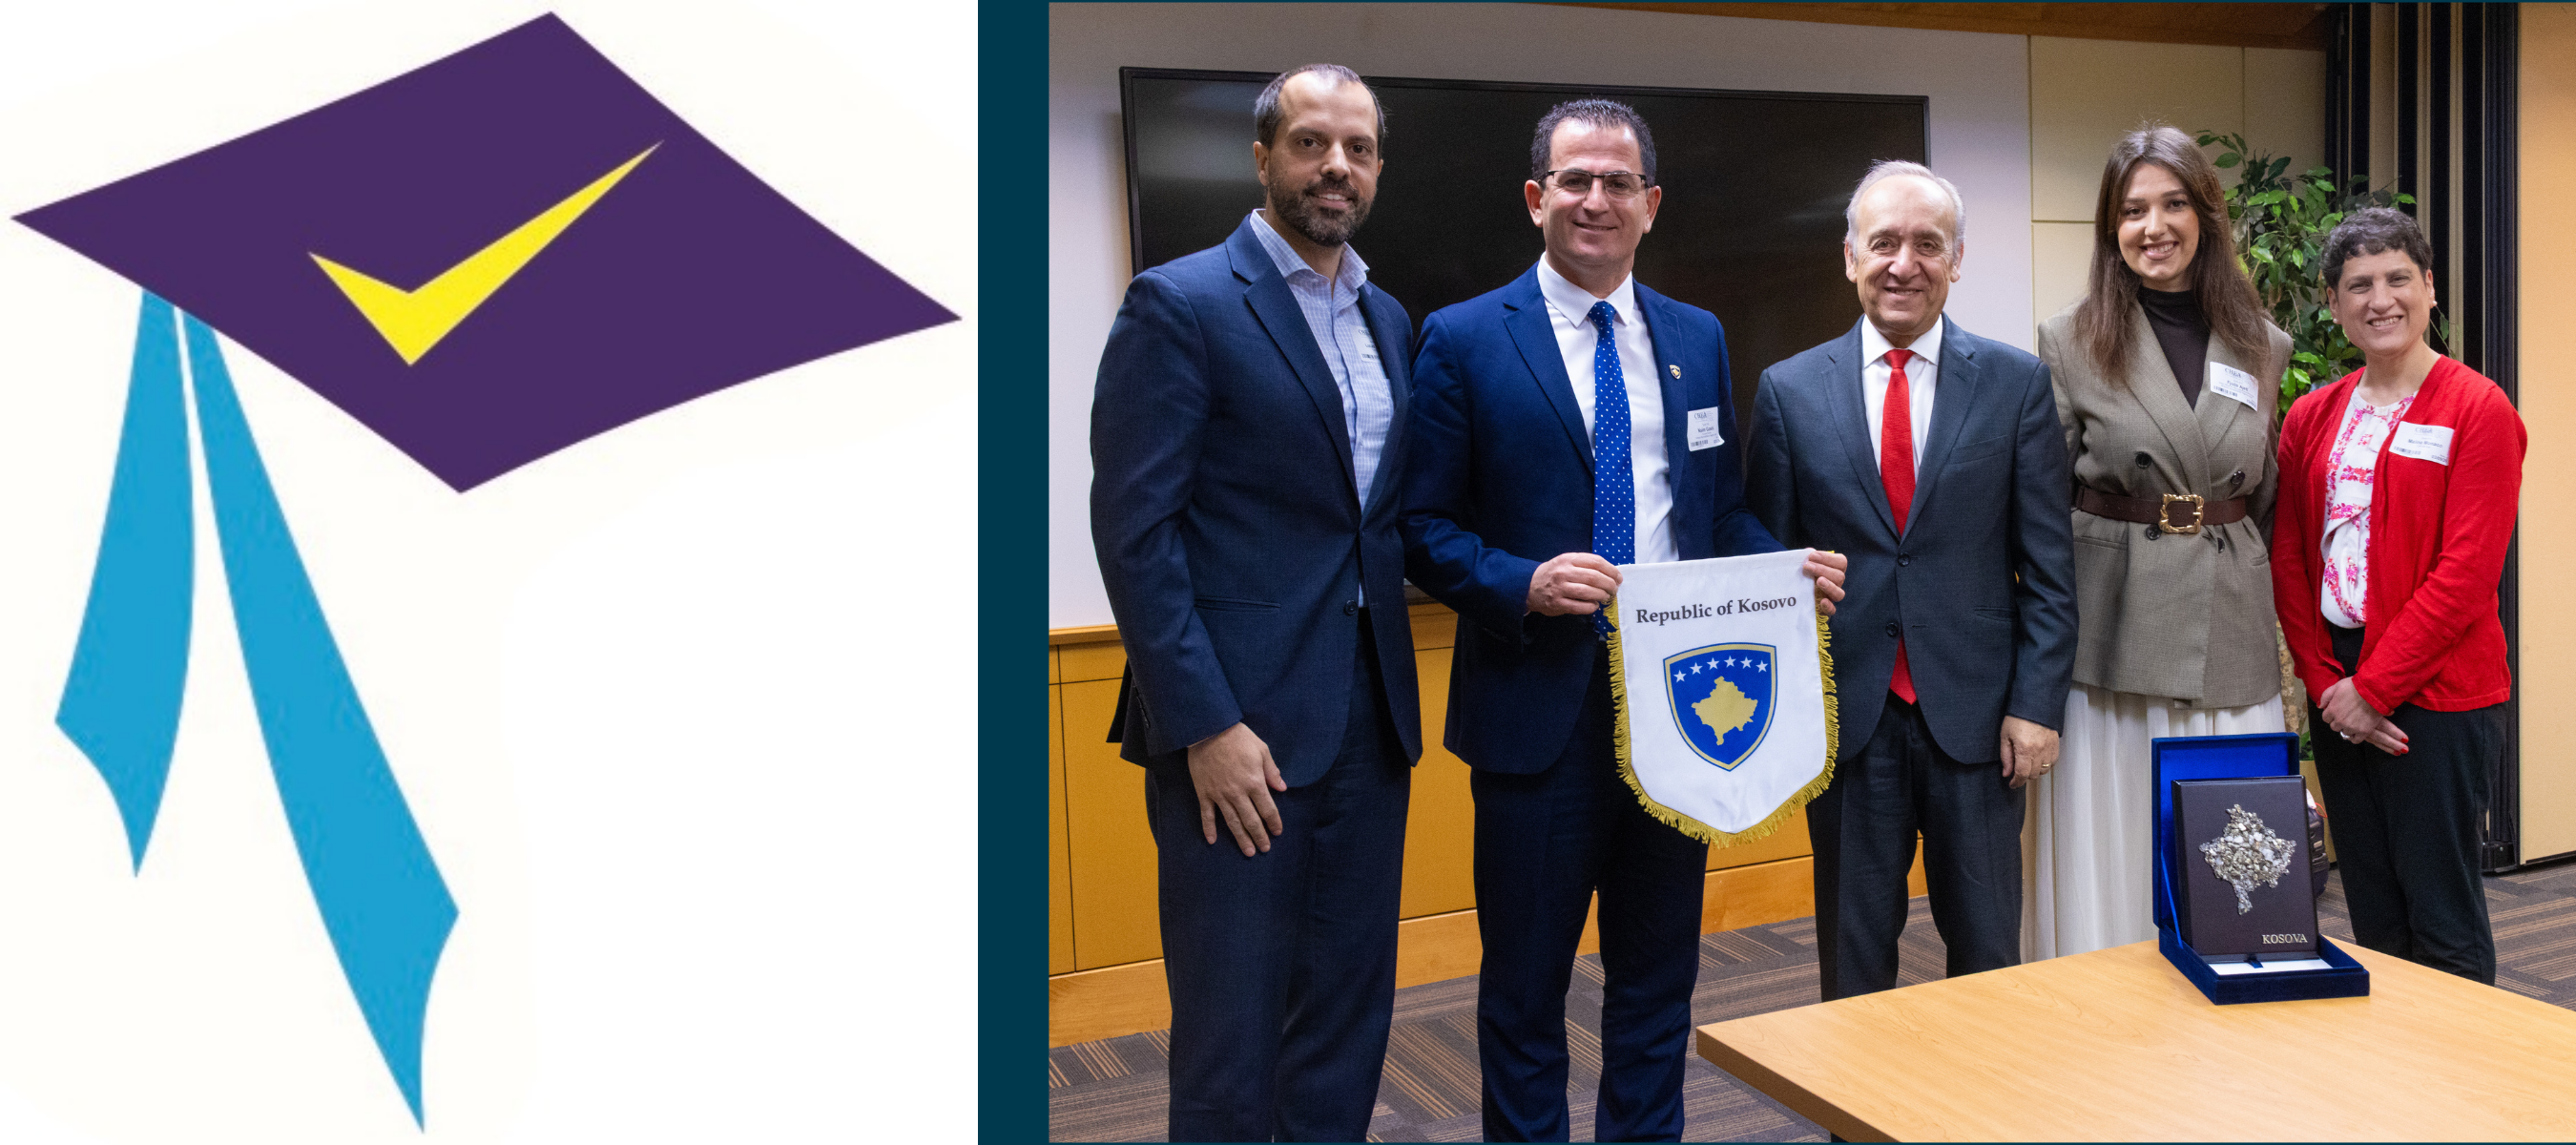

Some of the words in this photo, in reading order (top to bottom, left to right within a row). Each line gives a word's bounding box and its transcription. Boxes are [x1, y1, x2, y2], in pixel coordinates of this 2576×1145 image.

[1635, 603, 1713, 626] Republic
[1716, 600, 1734, 615] of
[1737, 596, 1797, 614] Kosovo
[2262, 933, 2308, 944] KOSOVA
